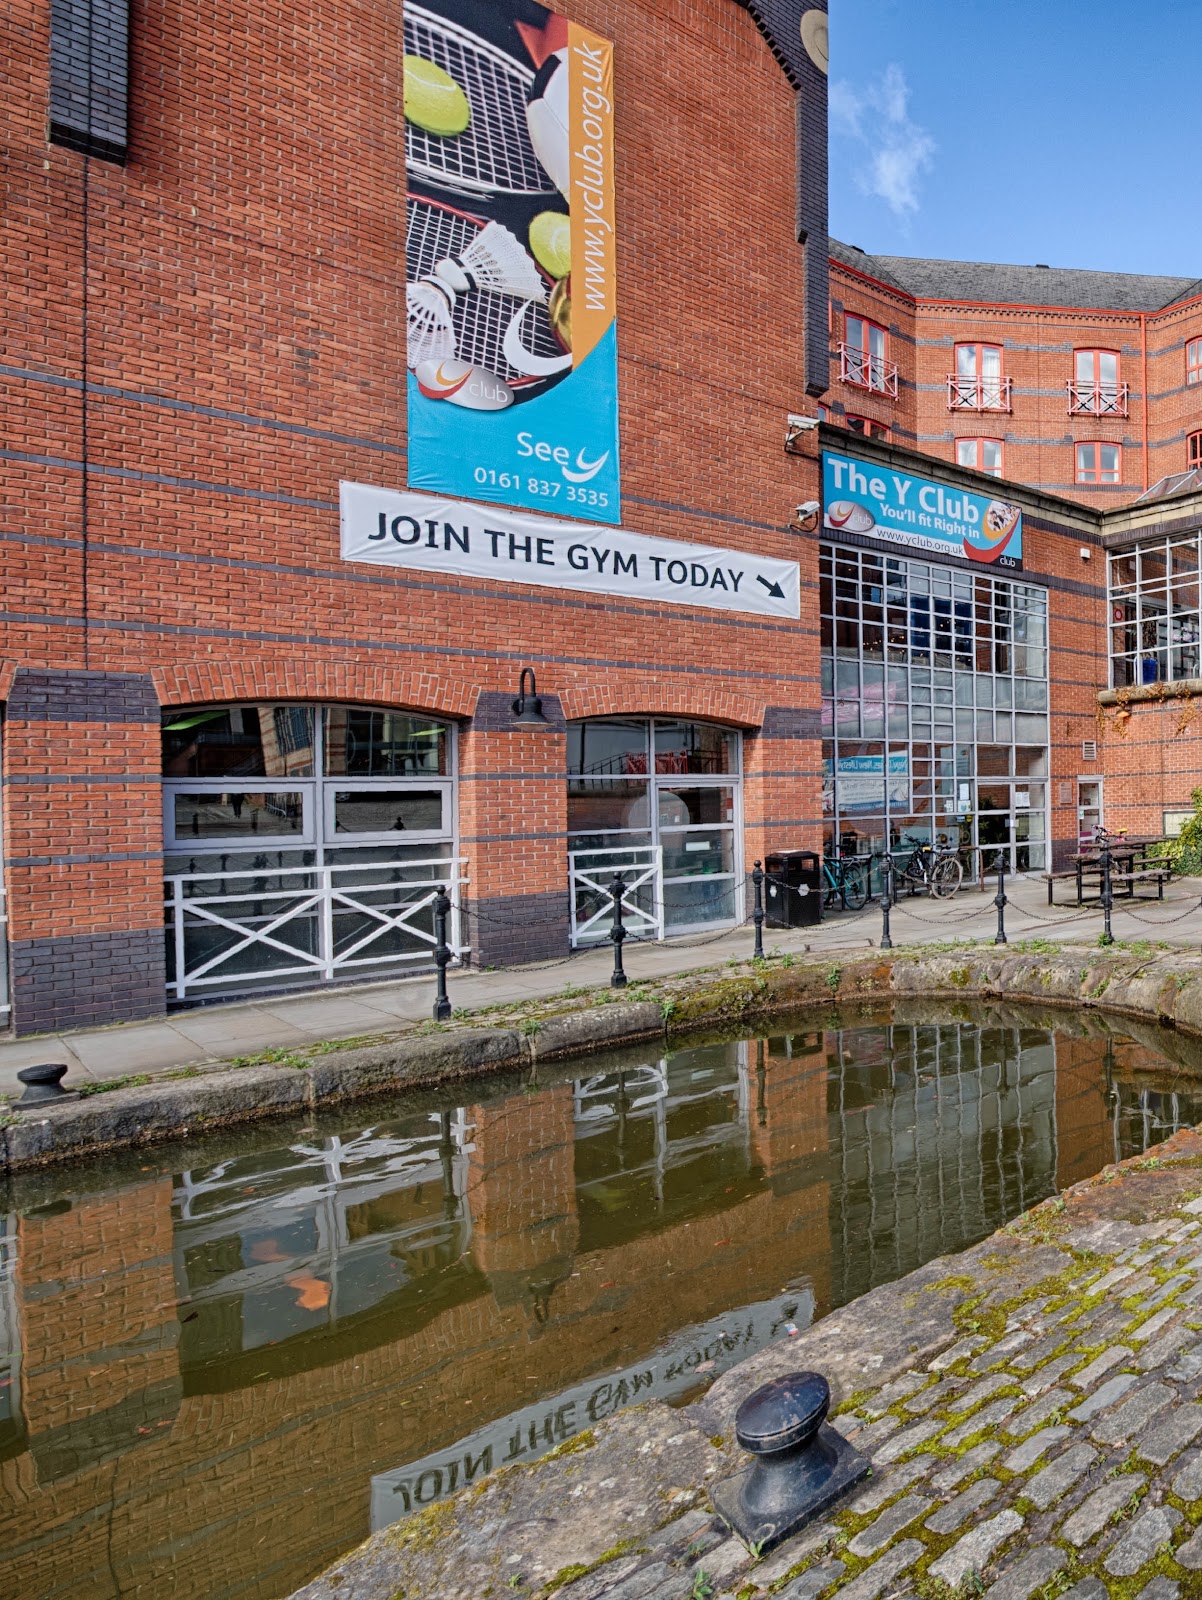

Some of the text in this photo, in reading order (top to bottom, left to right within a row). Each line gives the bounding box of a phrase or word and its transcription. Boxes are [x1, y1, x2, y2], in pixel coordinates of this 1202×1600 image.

[573, 41, 613, 311] www.yclub.org.uk
[468, 381, 508, 403] club
[517, 431, 570, 465] See
[474, 467, 609, 507] 0161 837 3535
[828, 457, 979, 523] The Y Club
[852, 510, 872, 527] club
[880, 503, 980, 539] You'll fit Right in
[368, 513, 744, 593] JOIN THE GYM TODAY
[877, 529, 963, 556] www.yclub.org.uk
[1000, 555, 1016, 568] club
